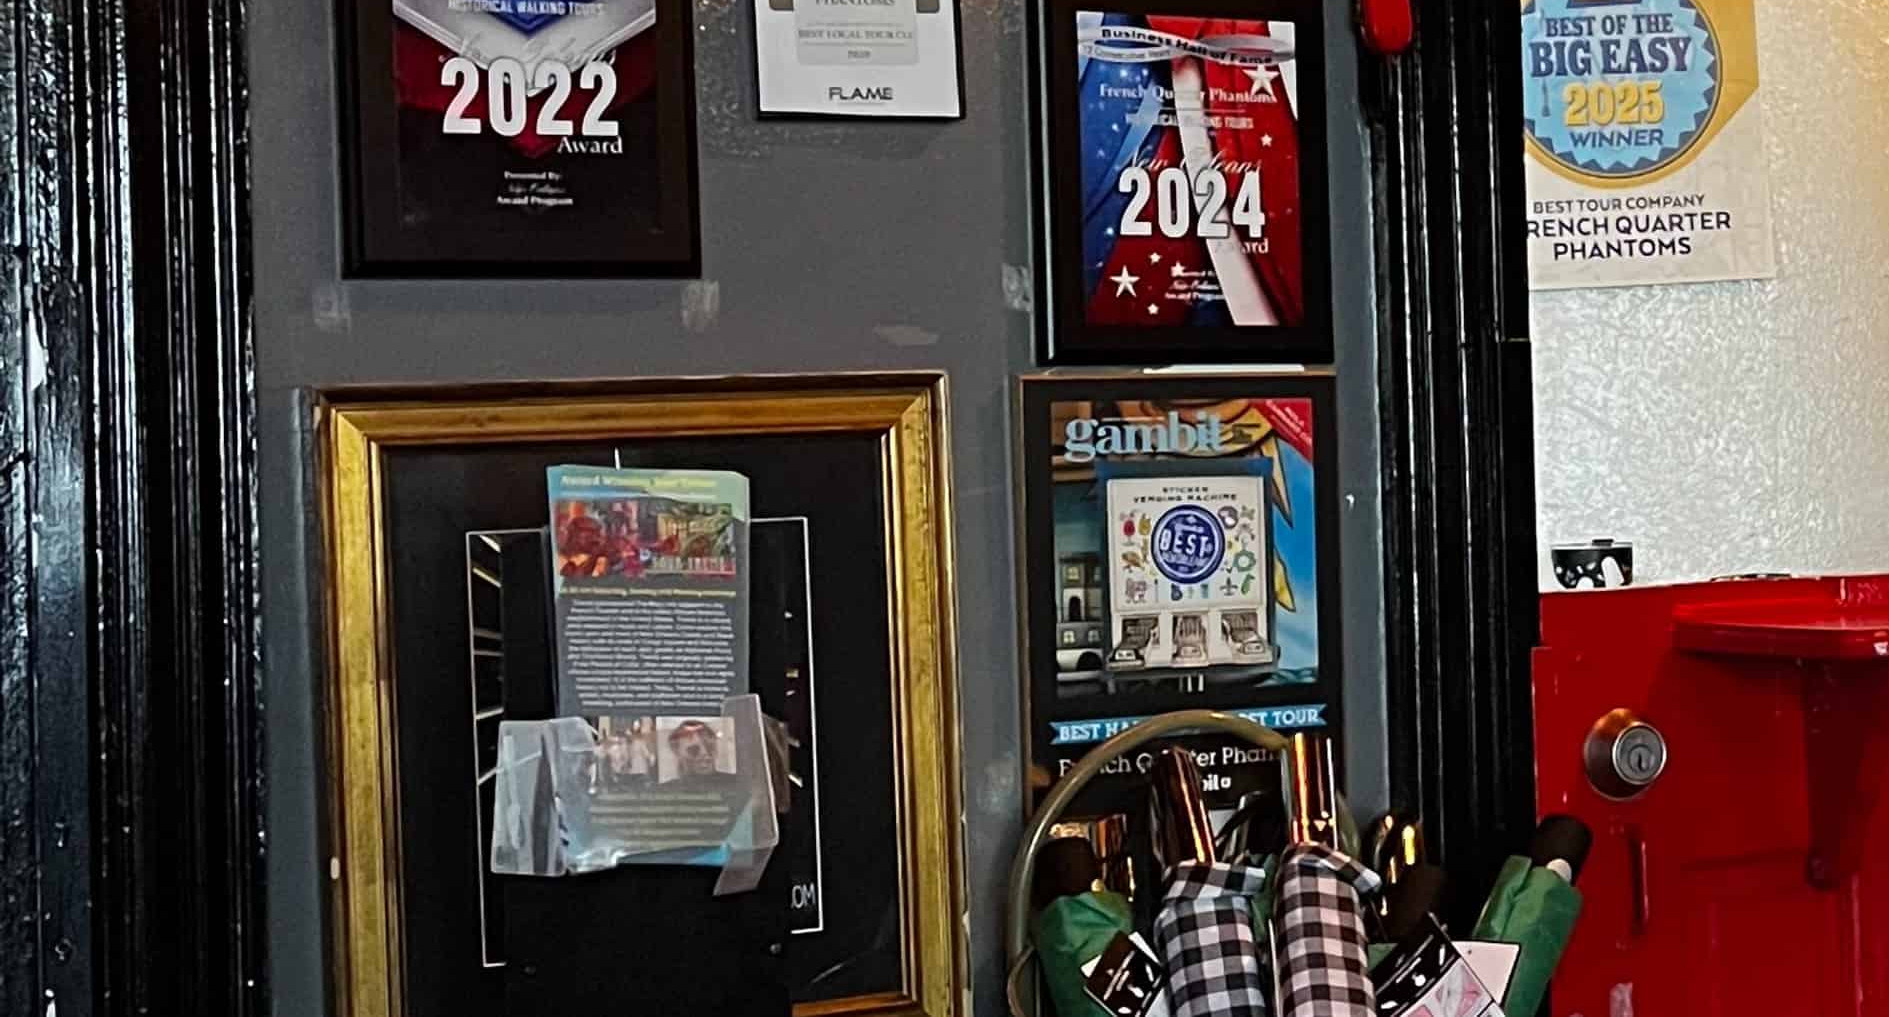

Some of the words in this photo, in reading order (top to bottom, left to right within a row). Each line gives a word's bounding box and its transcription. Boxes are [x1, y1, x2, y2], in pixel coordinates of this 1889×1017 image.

[516, 0, 567, 16] WALKING
[1545, 16, 1596, 38] BEST
[1601, 14, 1628, 36] OF
[1631, 13, 1673, 35] THE
[1102, 28, 1171, 46] Business
[1175, 37, 1207, 56] Hall
[1230, 53, 1274, 65] Fame
[1529, 40, 1592, 78] BIG
[1600, 36, 1693, 75] EASY
[440, 56, 619, 137] 2022
[829, 87, 893, 100] FLAME
[1563, 80, 1666, 127] 2025
[556, 134, 623, 155] Award
[1569, 129, 1665, 149] WINNER
[1118, 167, 1266, 239] 2024
[1534, 201, 1575, 214] BEST
[1577, 198, 1623, 213] TOUR
[1625, 193, 1706, 211] COMPANY
[1526, 215, 1609, 239] RENCH
[1615, 211, 1731, 236] QUARTER
[1554, 236, 1692, 261] PHANTOMS
[1063, 411, 1224, 463] gambit
[1159, 528, 1209, 558] BEST
[1059, 725, 1100, 742] BEST
[1271, 709, 1320, 725] TOUR
